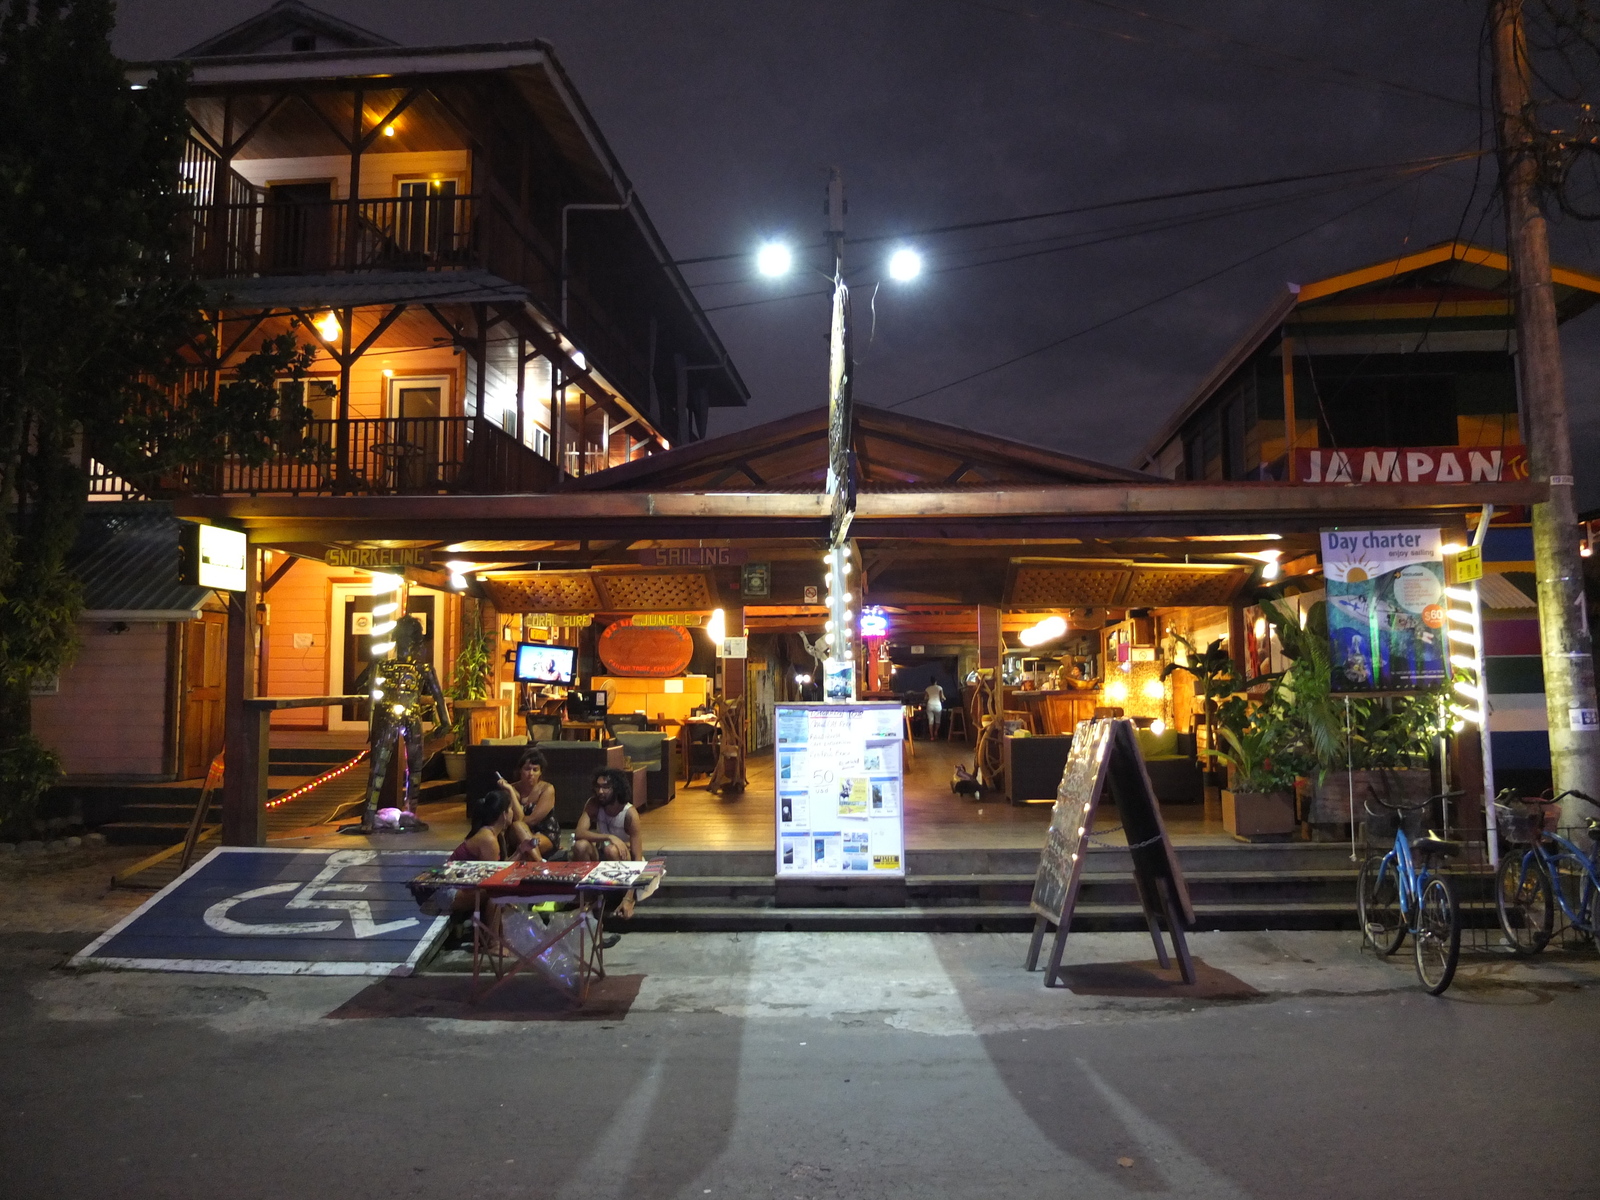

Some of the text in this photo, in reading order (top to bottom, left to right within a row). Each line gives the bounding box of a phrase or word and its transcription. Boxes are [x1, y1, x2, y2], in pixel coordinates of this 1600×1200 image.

[1303, 450, 1503, 482] JAMPAN
[1328, 531, 1422, 554] Day charter
[330, 549, 425, 566] SNORKELING
[656, 548, 730, 565] SAILING
[1388, 549, 1435, 558] enjoy sailing
[526, 614, 588, 627] CORAL SURF
[639, 614, 692, 627] JUNGLE
[813, 769, 835, 785] 50
